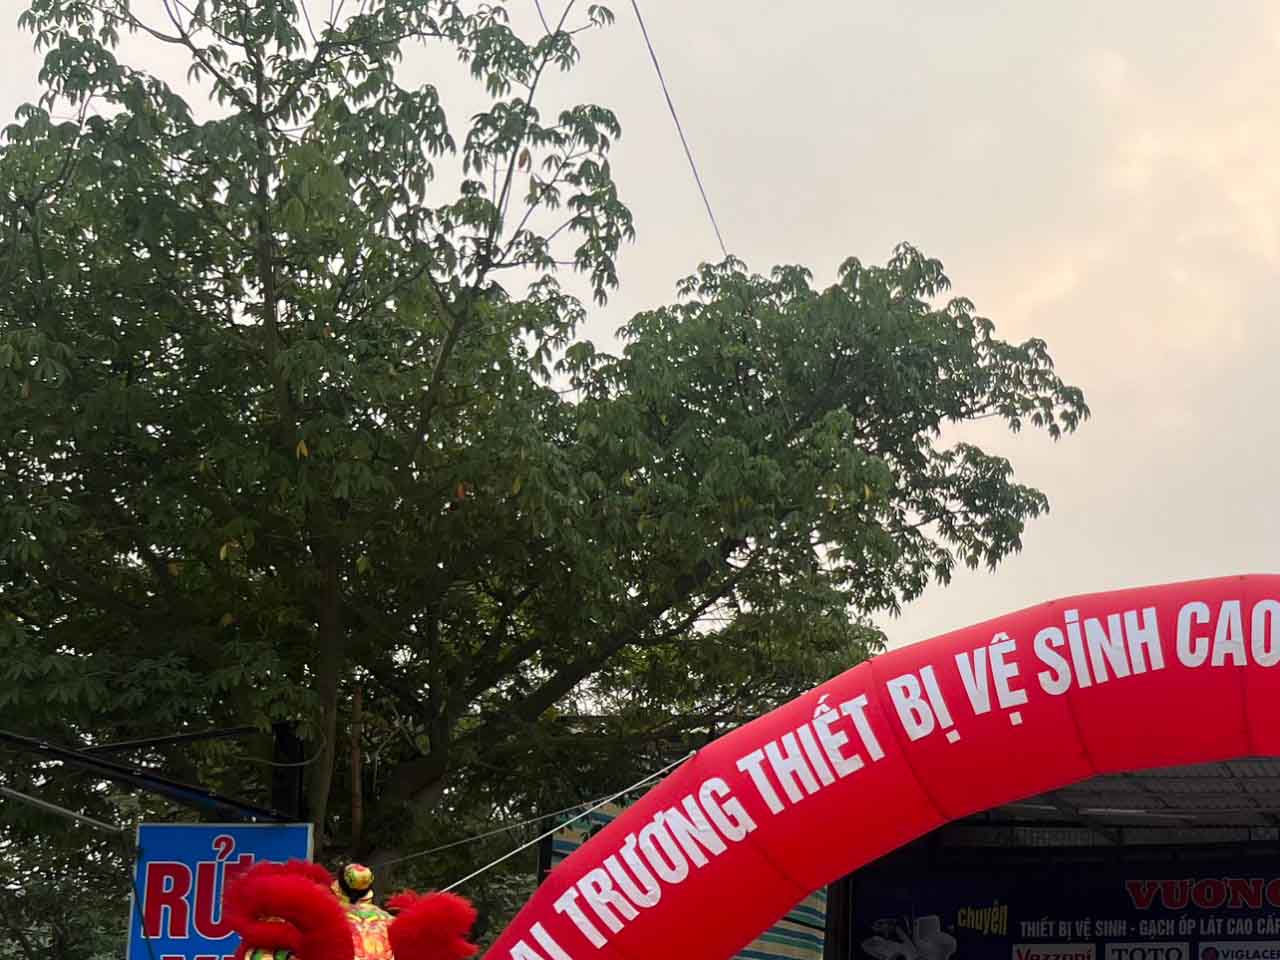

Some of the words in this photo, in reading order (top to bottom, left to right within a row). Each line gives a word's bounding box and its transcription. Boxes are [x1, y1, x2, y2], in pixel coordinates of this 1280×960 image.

[553, 776, 757, 949] TRƯƠNG
[736, 692, 886, 813] THIẾT
[887, 665, 961, 744] BỊ
[955, 632, 1028, 726] VỆ
[140, 834, 254, 940] RỬ
[1019, 913, 1056, 937] THIẾT
[1058, 919, 1072, 941] BỊ
[1073, 914, 1092, 941] VỆ
[1095, 919, 1127, 937] SINH
[1139, 919, 1175, 941] GẠCH
[1178, 913, 1197, 937] ỐP
[1199, 914, 1224, 937] LÁT
[1227, 918, 1253, 937] CAO
